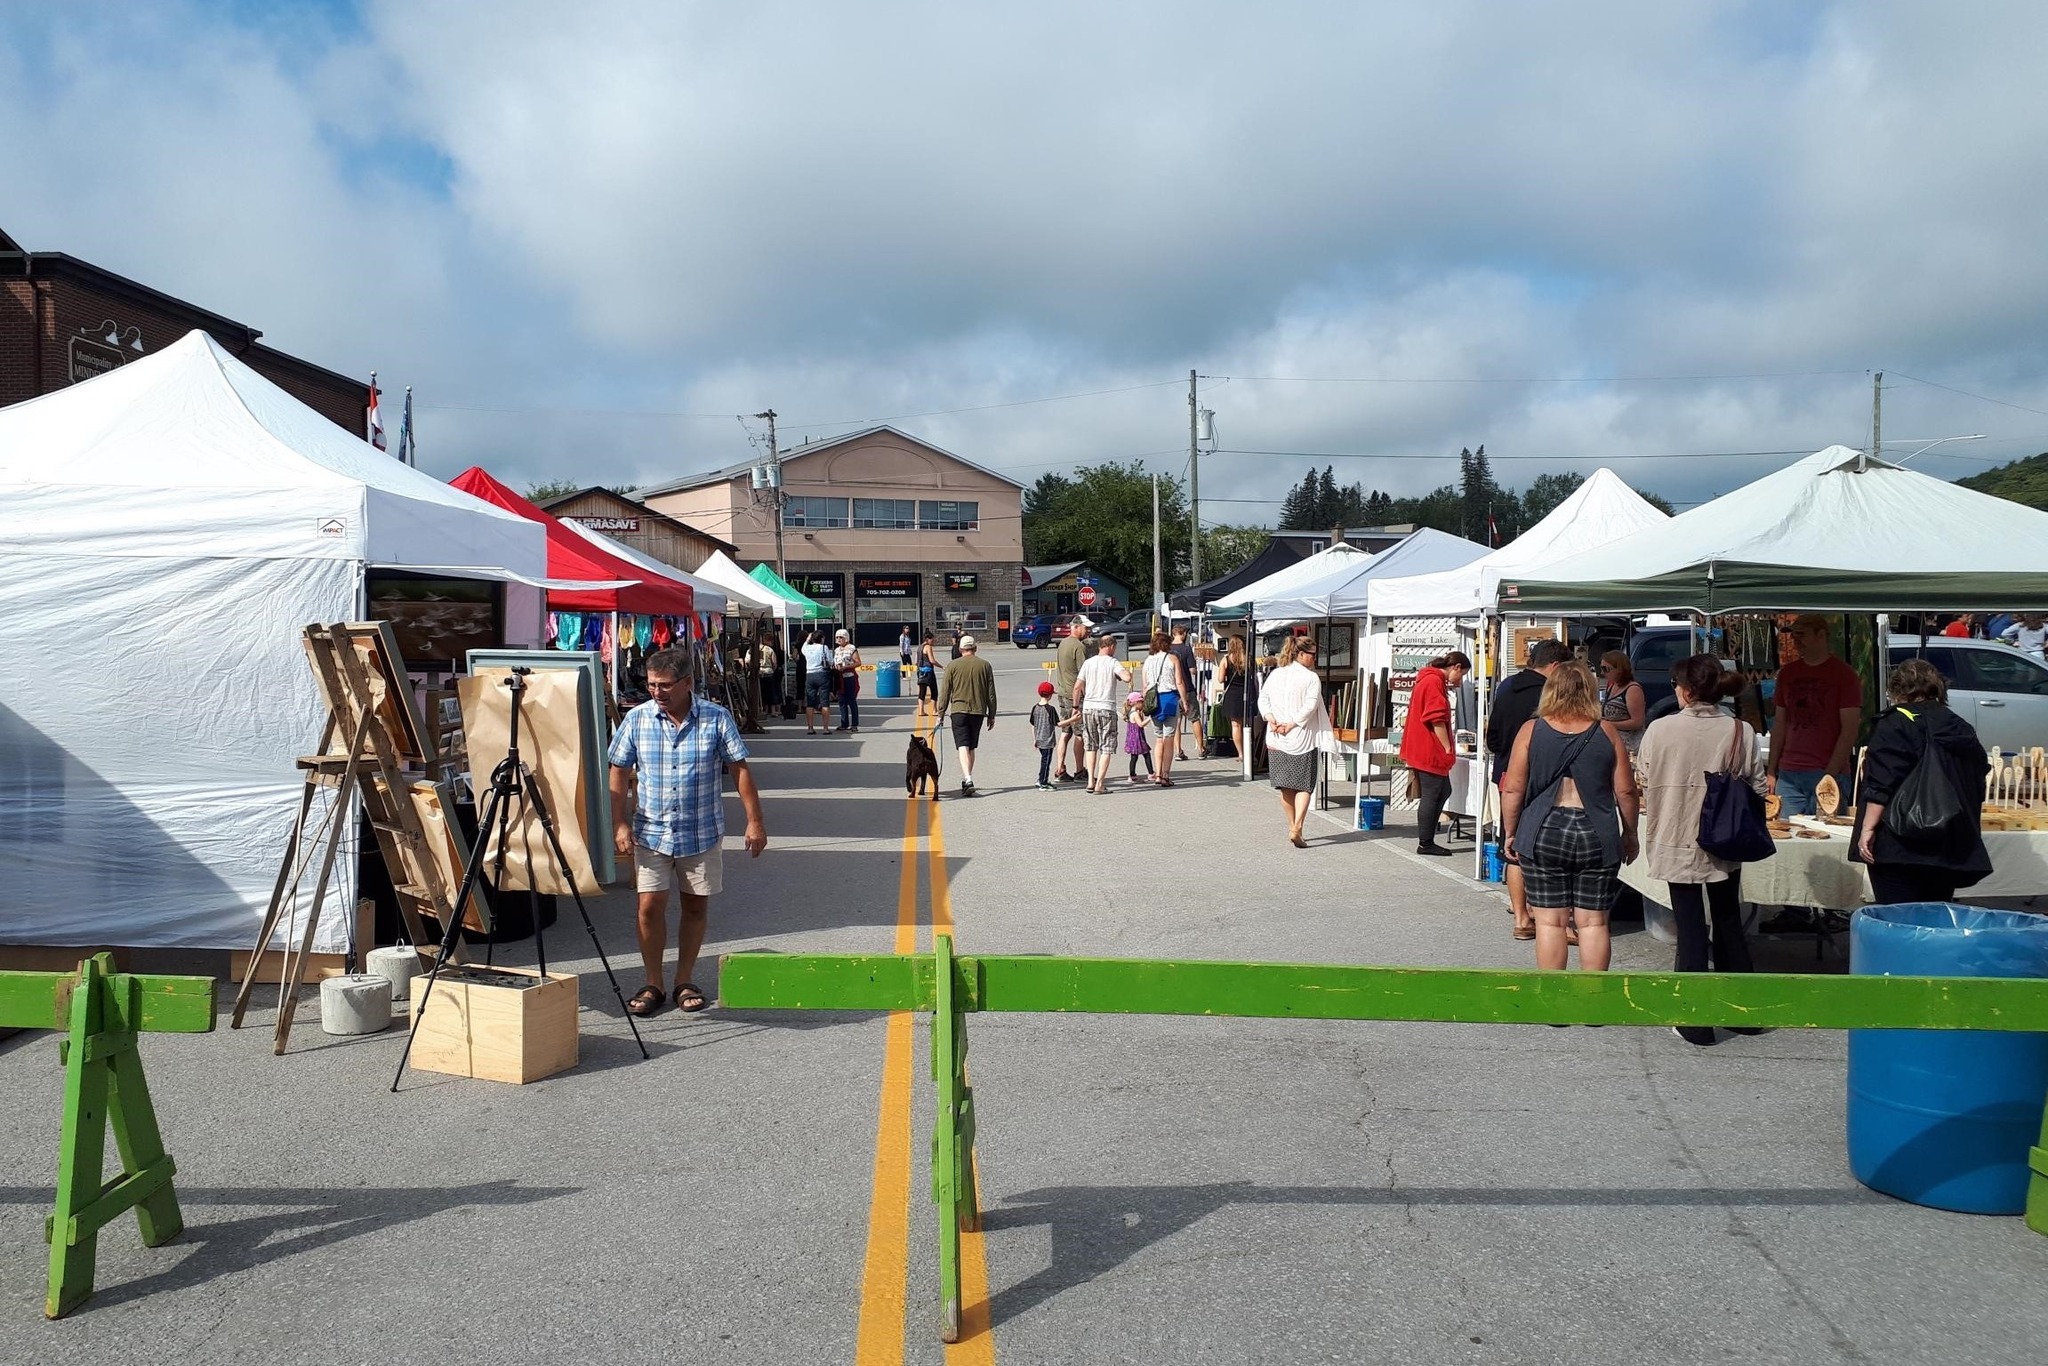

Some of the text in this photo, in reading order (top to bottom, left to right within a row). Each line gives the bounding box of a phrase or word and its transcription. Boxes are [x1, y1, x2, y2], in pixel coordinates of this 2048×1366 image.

[75, 350, 112, 370] Municipality
[74, 364, 101, 378] MINDE
[574, 519, 637, 530] ARMASAVE
[1080, 592, 1095, 600] STOP
[1395, 635, 1449, 644] Canning Lake
[1394, 657, 1430, 668] Miskwa
